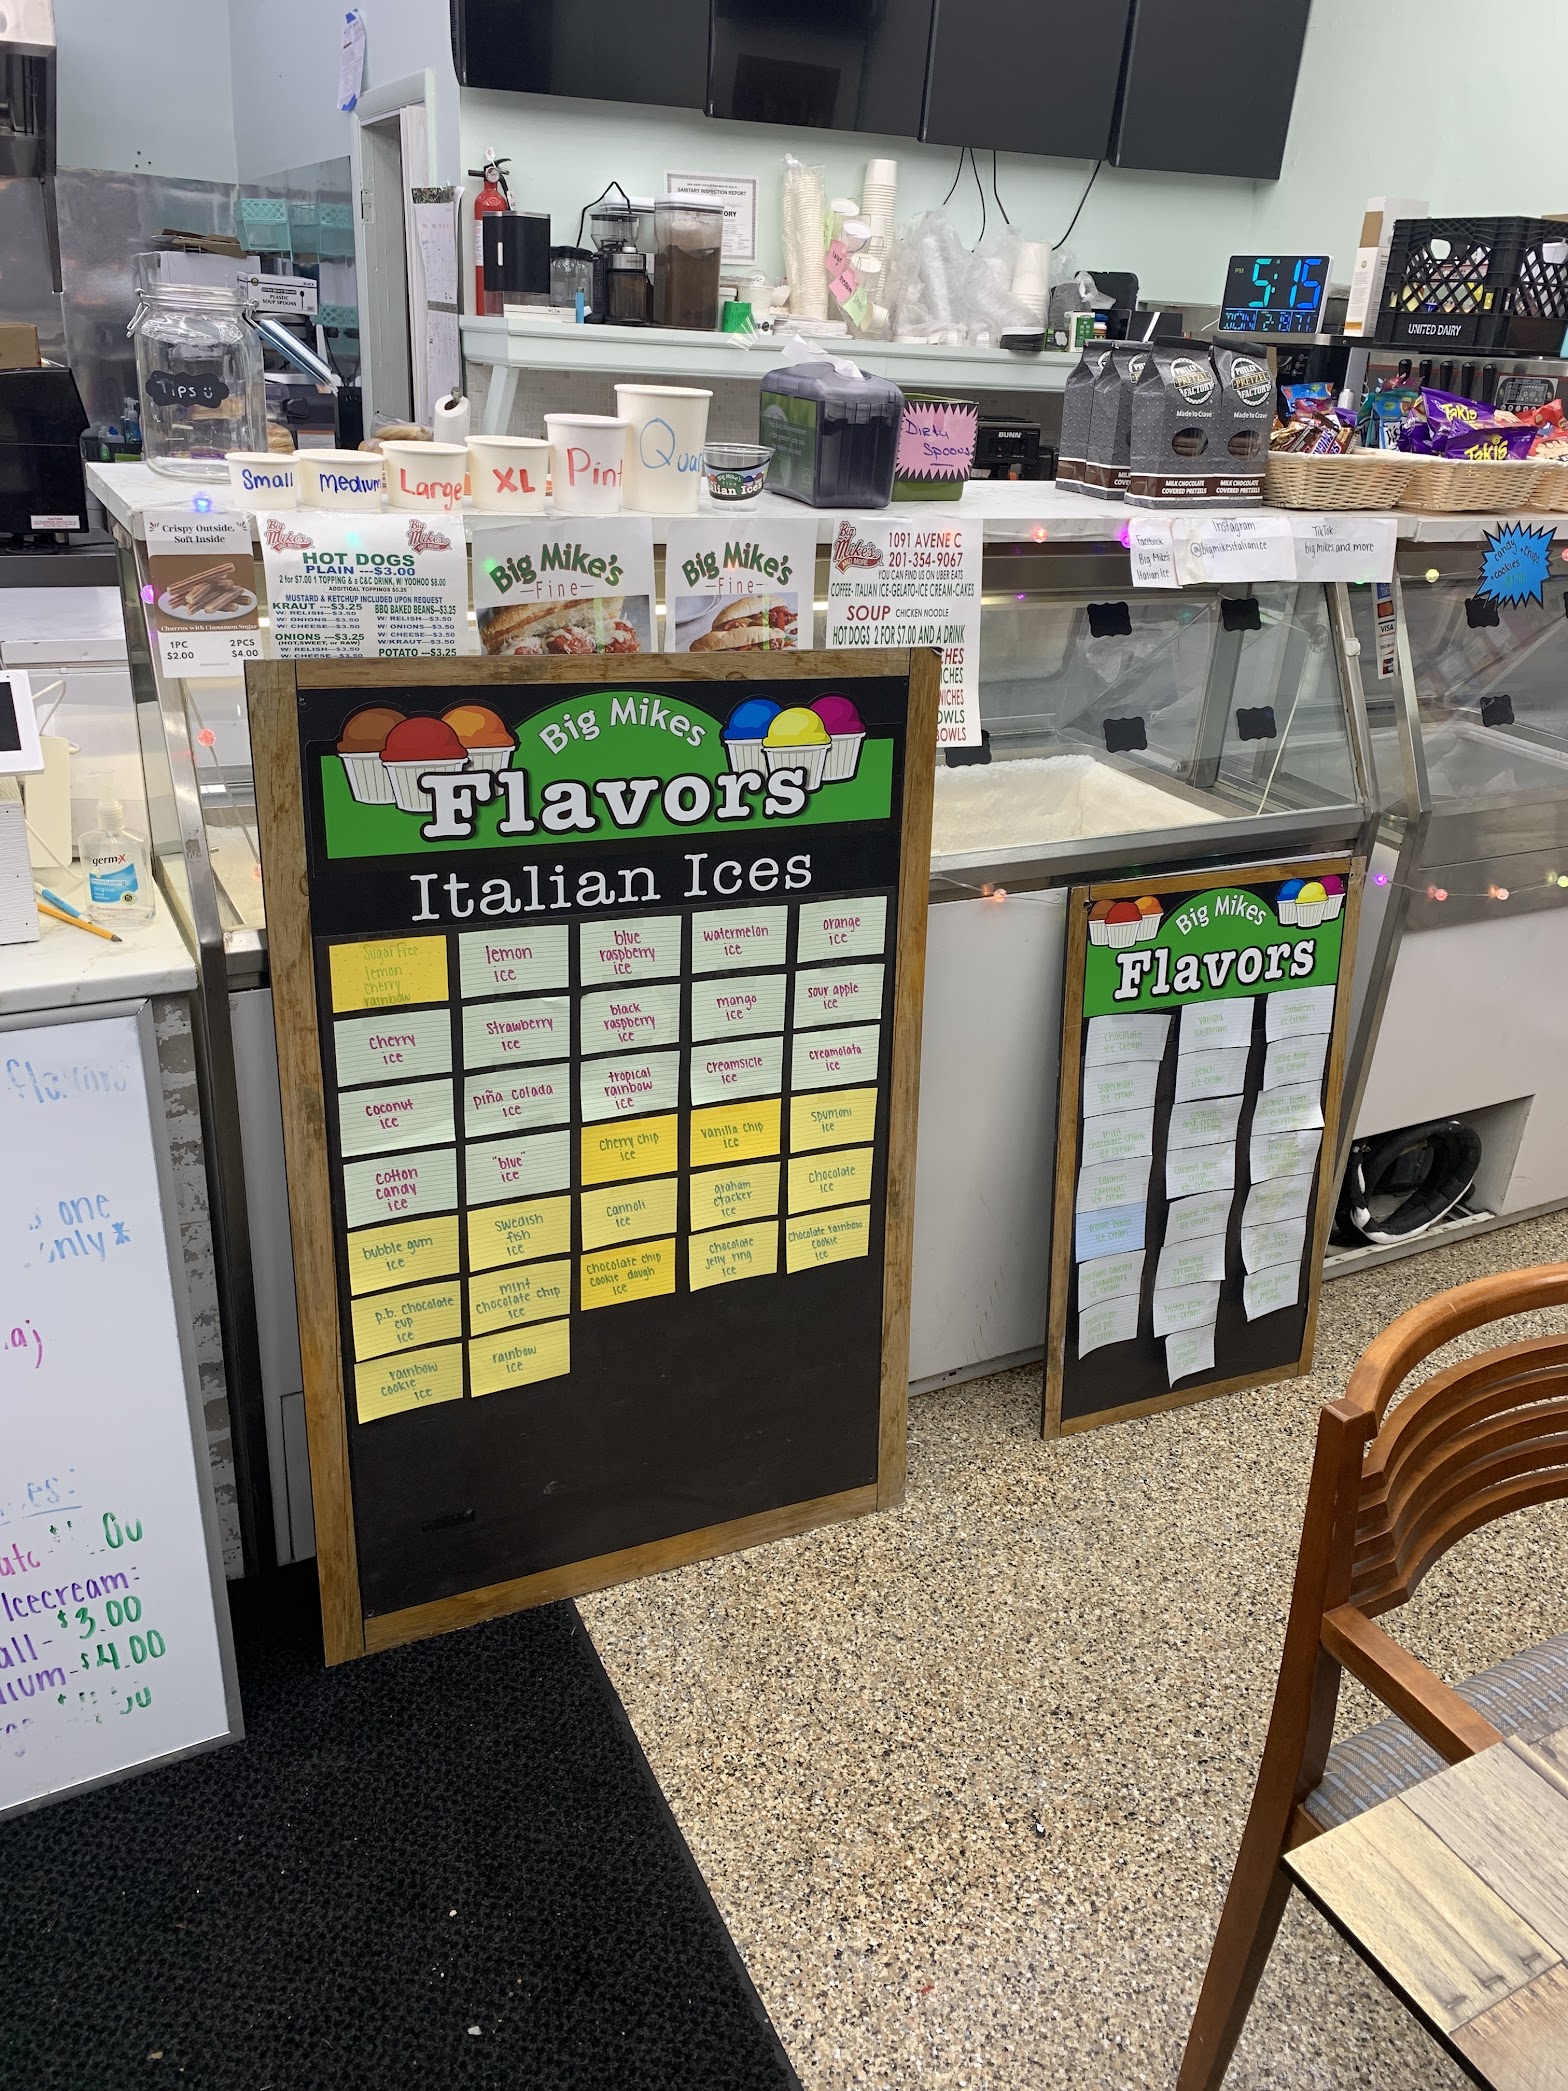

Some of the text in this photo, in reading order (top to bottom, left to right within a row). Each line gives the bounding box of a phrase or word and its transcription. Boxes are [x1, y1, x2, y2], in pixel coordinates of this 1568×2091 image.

[1248, 259, 1322, 309] 5:15
[1408, 324, 1462, 337] UNITED DAIRY
[1175, 364, 1197, 375] PHILLY
[1235, 365, 1257, 375] PHILLY
[1177, 373, 1209, 385] PRETZEL
[1235, 374, 1269, 388] PRETZEL
[1181, 383, 1215, 397] FACTORY
[1240, 384, 1272, 399] FACTORY
[1442, 403, 1477, 421] Takis
[998, 431, 1022, 439] BUNN
[1464, 435, 1508, 460] Takis
[567, 447, 623, 487] Pint
[242, 468, 293, 490] Small
[492, 467, 536, 494] XL
[400, 468, 462, 510] Large
[741, 483, 762, 494] Ices
[162, 524, 193, 534] Crispy
[839, 521, 856, 538] Big
[1212, 520, 1256, 537] Instagram
[174, 535, 225, 543] Soft Inside
[889, 532, 962, 548] 1091 AVENE C
[1137, 536, 1164, 546] Facebook
[834, 538, 876, 560] Mike's
[1494, 540, 1517, 561] candy
[303, 552, 414, 567] HOT DOGS
[681, 541, 794, 588] Big Mike's
[888, 552, 963, 567] 201-354-9067
[1138, 553, 1151, 567] Big
[306, 565, 354, 574] PLAIN
[488, 542, 624, 595] Big Mike's
[878, 570, 963, 580] YOU CAN FIND US ON UBER EATS
[1137, 568, 1159, 581] Italian
[855, 583, 878, 597] ITALIAN
[879, 583, 928, 597] ICE-GELATO-ICE
[930, 583, 974, 597] CREAM-CAKES
[375, 605, 411, 614] BBQ BAKED
[847, 605, 949, 621] SOUP CHICKEN NOODLE
[833, 625, 965, 645] HOT DOGS 2 FOR $7.00 AND A DRINK
[1380, 624, 1394, 632] VISA
[167, 650, 258, 660] $2.00 $4.00
[536, 697, 708, 756] Big Mikes
[419, 767, 808, 840] Flavors
[92, 854, 126, 866] germ-X
[409, 851, 812, 922] Italian Ices
[1175, 894, 1267, 936] Big Mikes
[823, 916, 861, 933] orange
[614, 930, 641, 946] blue
[703, 925, 769, 942] watermelon
[829, 932, 848, 946] ice
[485, 945, 533, 964] lemon
[599, 946, 655, 963] raspberry
[724, 943, 743, 956] ice
[493, 966, 517, 982] ice
[613, 961, 632, 975] ice
[1113, 938, 1315, 1001] Flavors
[808, 982, 859, 999] sour apple
[823, 997, 838, 1009] ice
[369, 1034, 416, 1050] cherry
[383, 1052, 404, 1065] ice
[608, 1067, 651, 1083] tropical
[473, 1084, 553, 1109] piña colada
[604, 1080, 653, 1097] rainbow
[501, 1104, 522, 1117] ice
[614, 1096, 635, 1110] ice
[375, 1167, 418, 1185] cotton
[375, 1182, 417, 1200] candy
[59, 1194, 110, 1226] one
[387, 1198, 408, 1212] ice
[606, 1199, 646, 1217] cannoli
[615, 1215, 631, 1228] ice
[363, 1236, 433, 1261] bubble gum
[385, 1256, 406, 1272] ice
[57, 1595, 142, 1640] $3.00
[81, 1629, 166, 1672] $4.00
